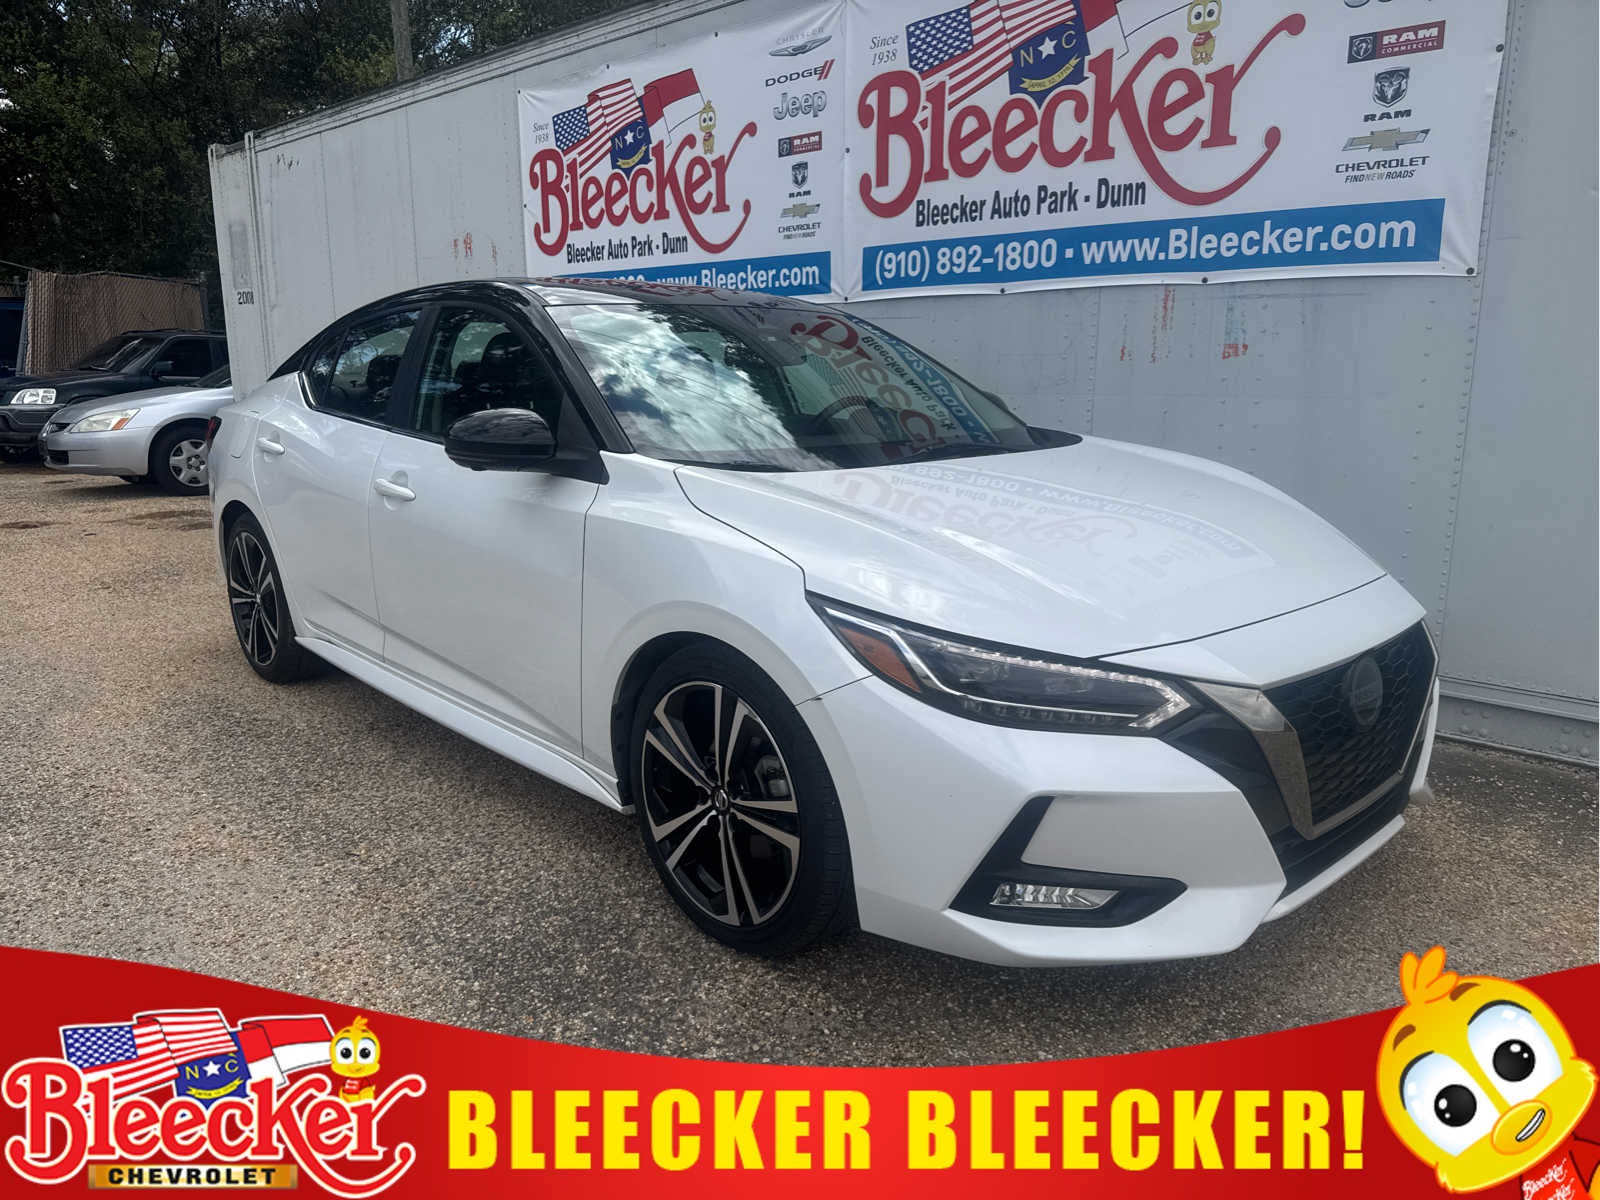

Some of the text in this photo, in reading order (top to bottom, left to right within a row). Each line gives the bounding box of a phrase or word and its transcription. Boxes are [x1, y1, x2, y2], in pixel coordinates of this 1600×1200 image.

[870, 34, 898, 50] Since
[1382, 27, 1440, 45] RAM
[1382, 41, 1438, 54] COMMERCIAL
[871, 50, 898, 66] 1938
[765, 65, 824, 87] DODGE
[773, 90, 828, 120] Jeep
[858, 13, 1306, 219] Bleecker
[1363, 109, 1412, 122] RAM
[794, 136, 820, 146] RAM
[1335, 156, 1430, 173] CHEVROLET
[529, 121, 757, 257] Bleecker
[788, 190, 812, 199] RAM
[915, 178, 1146, 227] Bleecker Auto Park Dunn
[778, 222, 822, 234] CHEVROLET
[567, 232, 688, 264] Bleecker Auto Park Dunn
[875, 219, 1416, 285] (910) 892-1800 www.Bleecker.com
